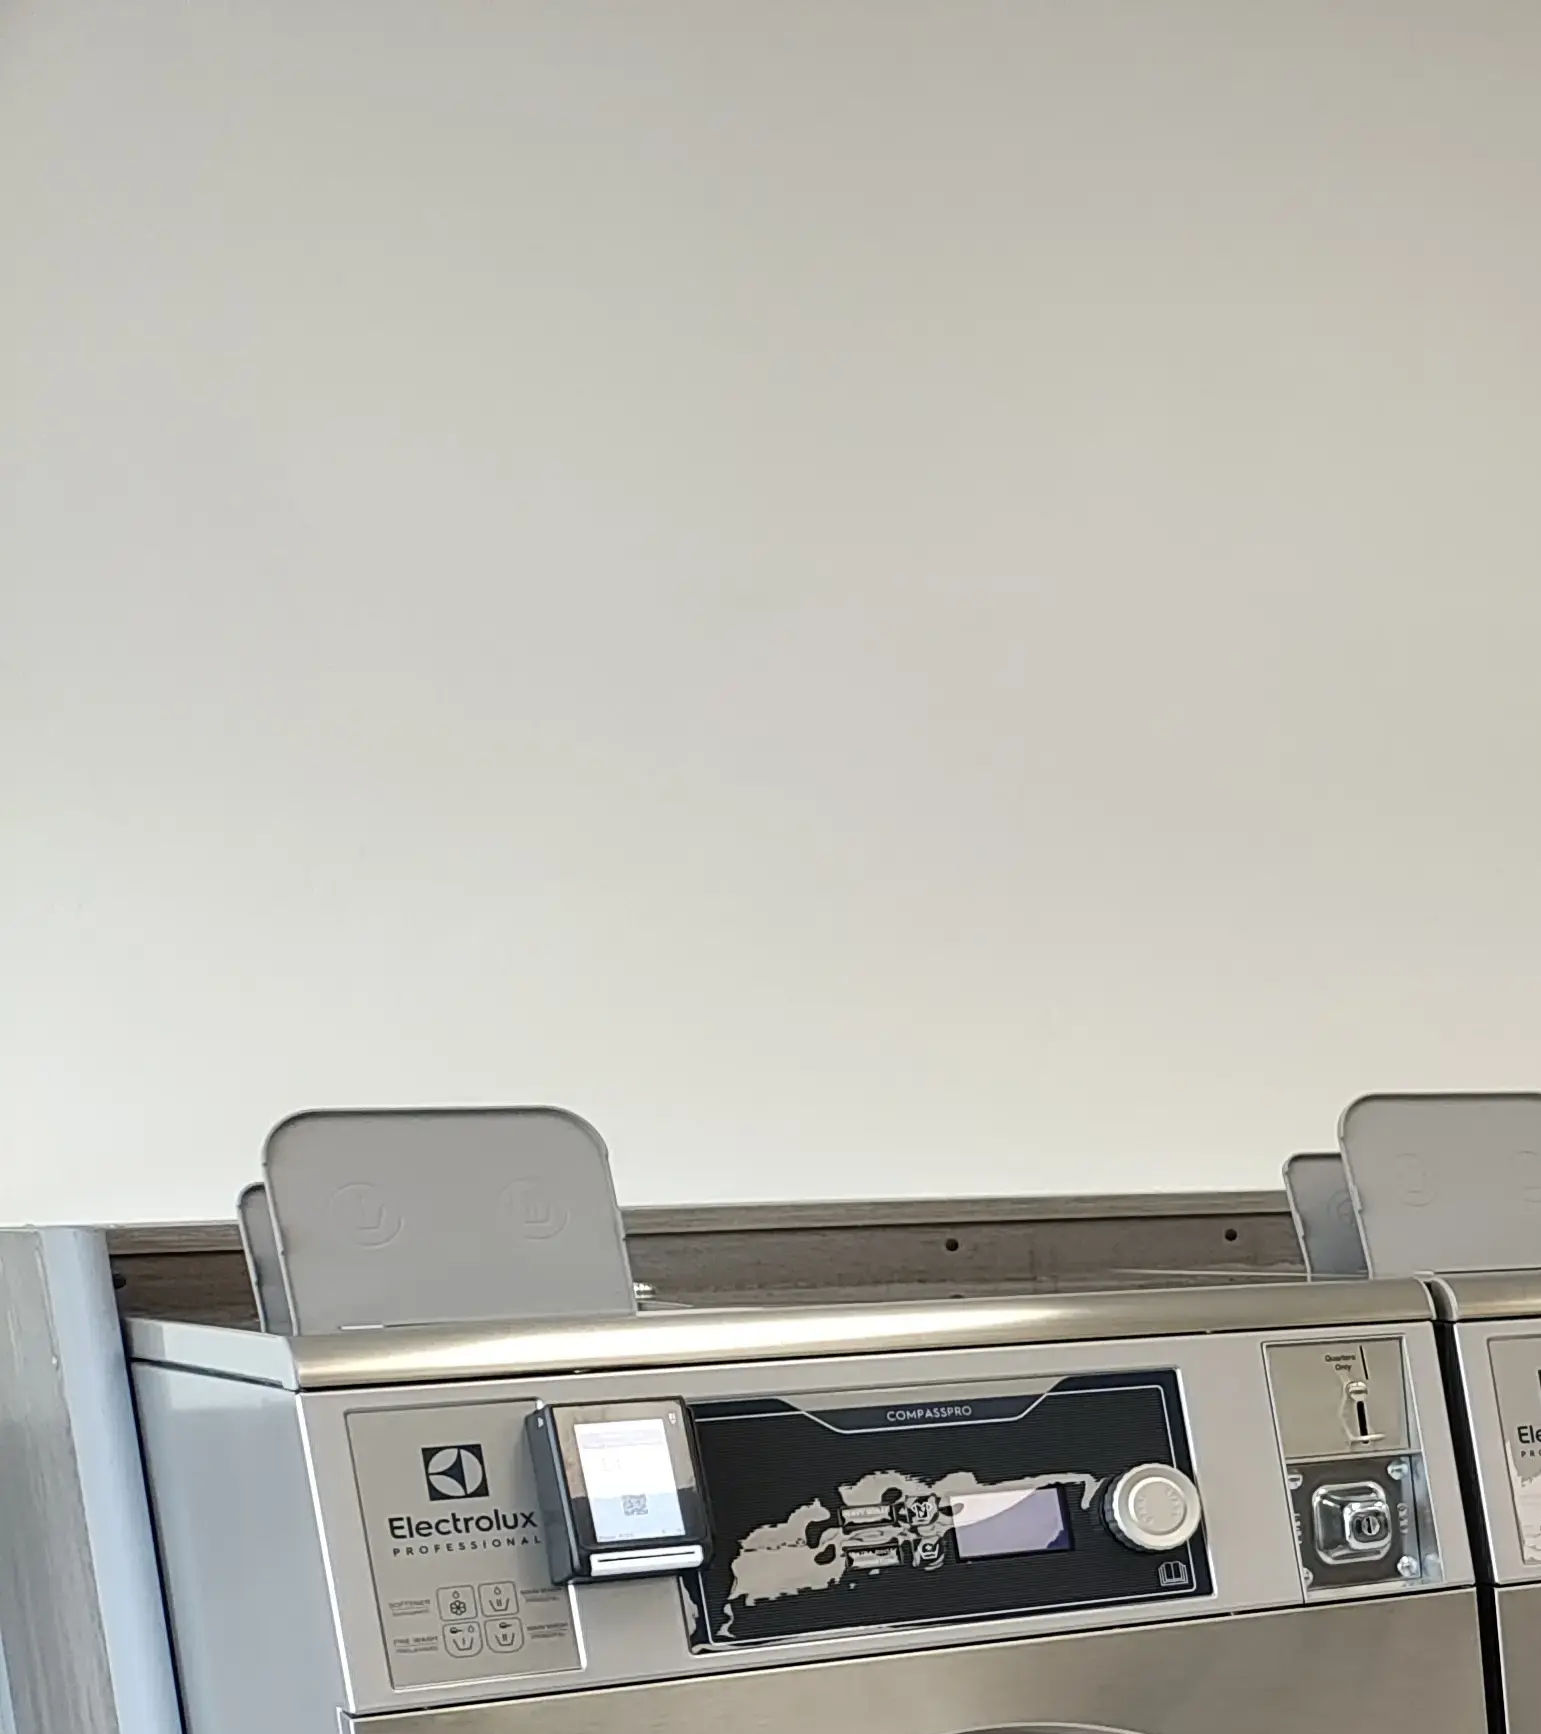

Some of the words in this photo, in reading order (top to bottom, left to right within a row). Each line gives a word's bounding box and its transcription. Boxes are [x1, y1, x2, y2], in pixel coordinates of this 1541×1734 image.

[1325, 1353, 1356, 1363] Quarters
[1335, 1363, 1352, 1372] Only
[886, 1405, 972, 1422] COMPASSPRO
[388, 1508, 538, 1540] Electrolux
[393, 1535, 542, 1557] PROFESSIONAL
